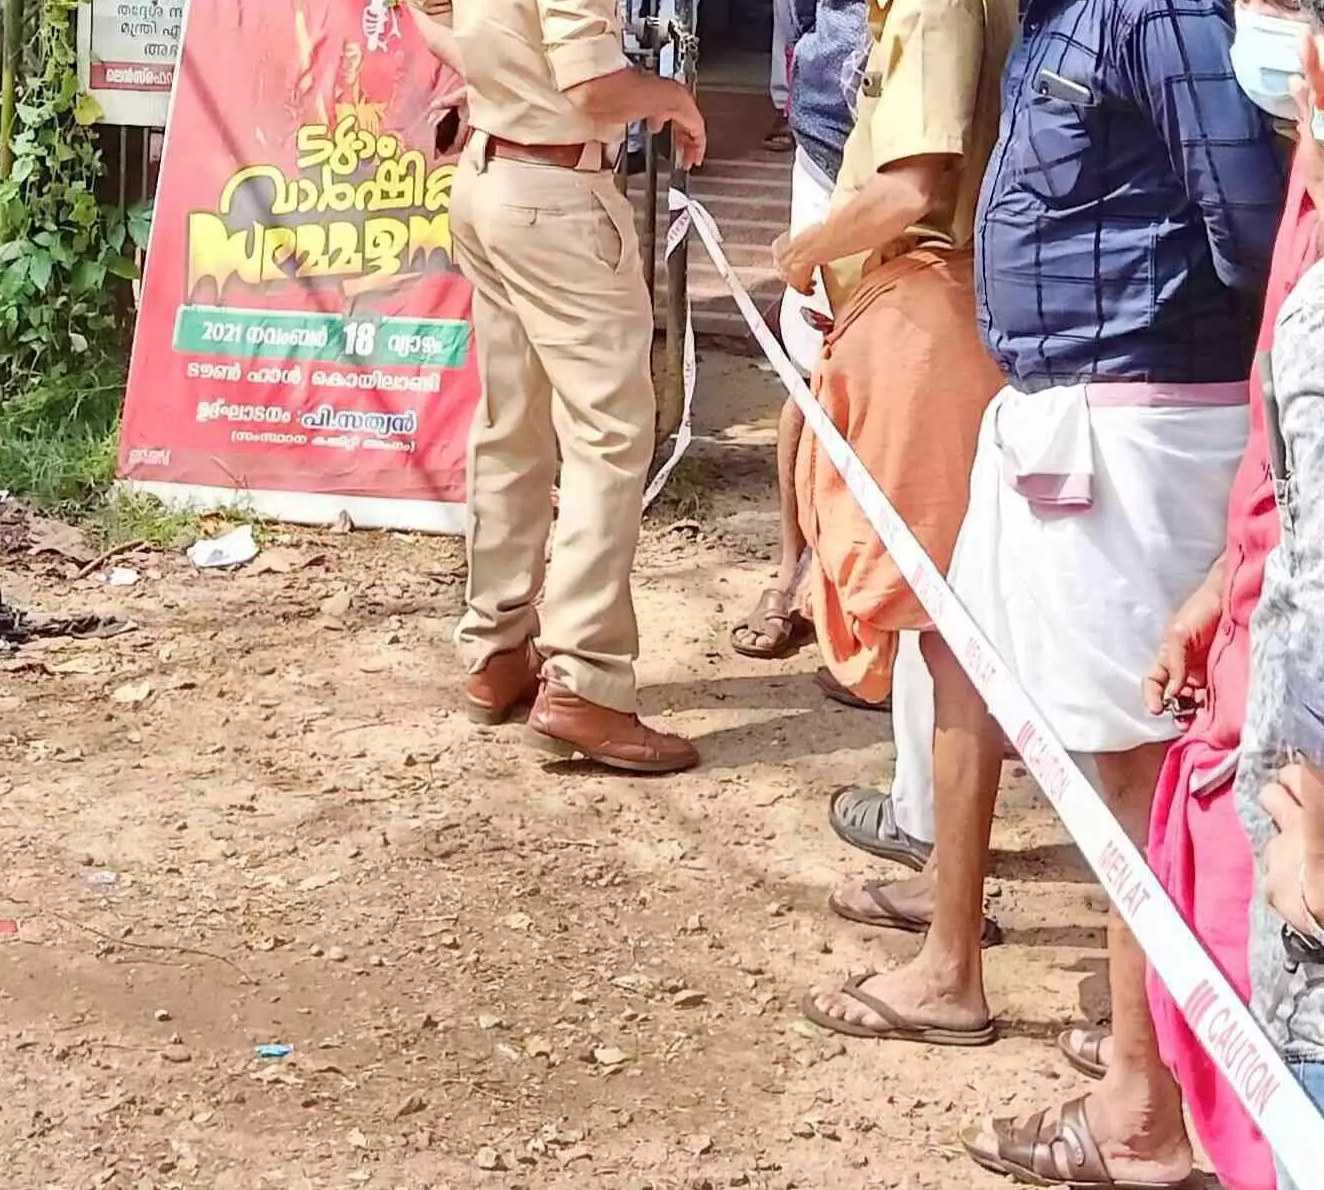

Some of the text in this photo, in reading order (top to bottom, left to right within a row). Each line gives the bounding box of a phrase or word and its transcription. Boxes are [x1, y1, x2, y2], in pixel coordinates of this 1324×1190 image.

[202, 321, 241, 343] 2021
[246, 323, 328, 348] നവംബർ
[342, 321, 376, 356] 18
[311, 370, 441, 393] കൊയിലാണ്ടി
[1099, 840, 1151, 917] MEN AT
[1208, 1006, 1281, 1116] CAUTION
